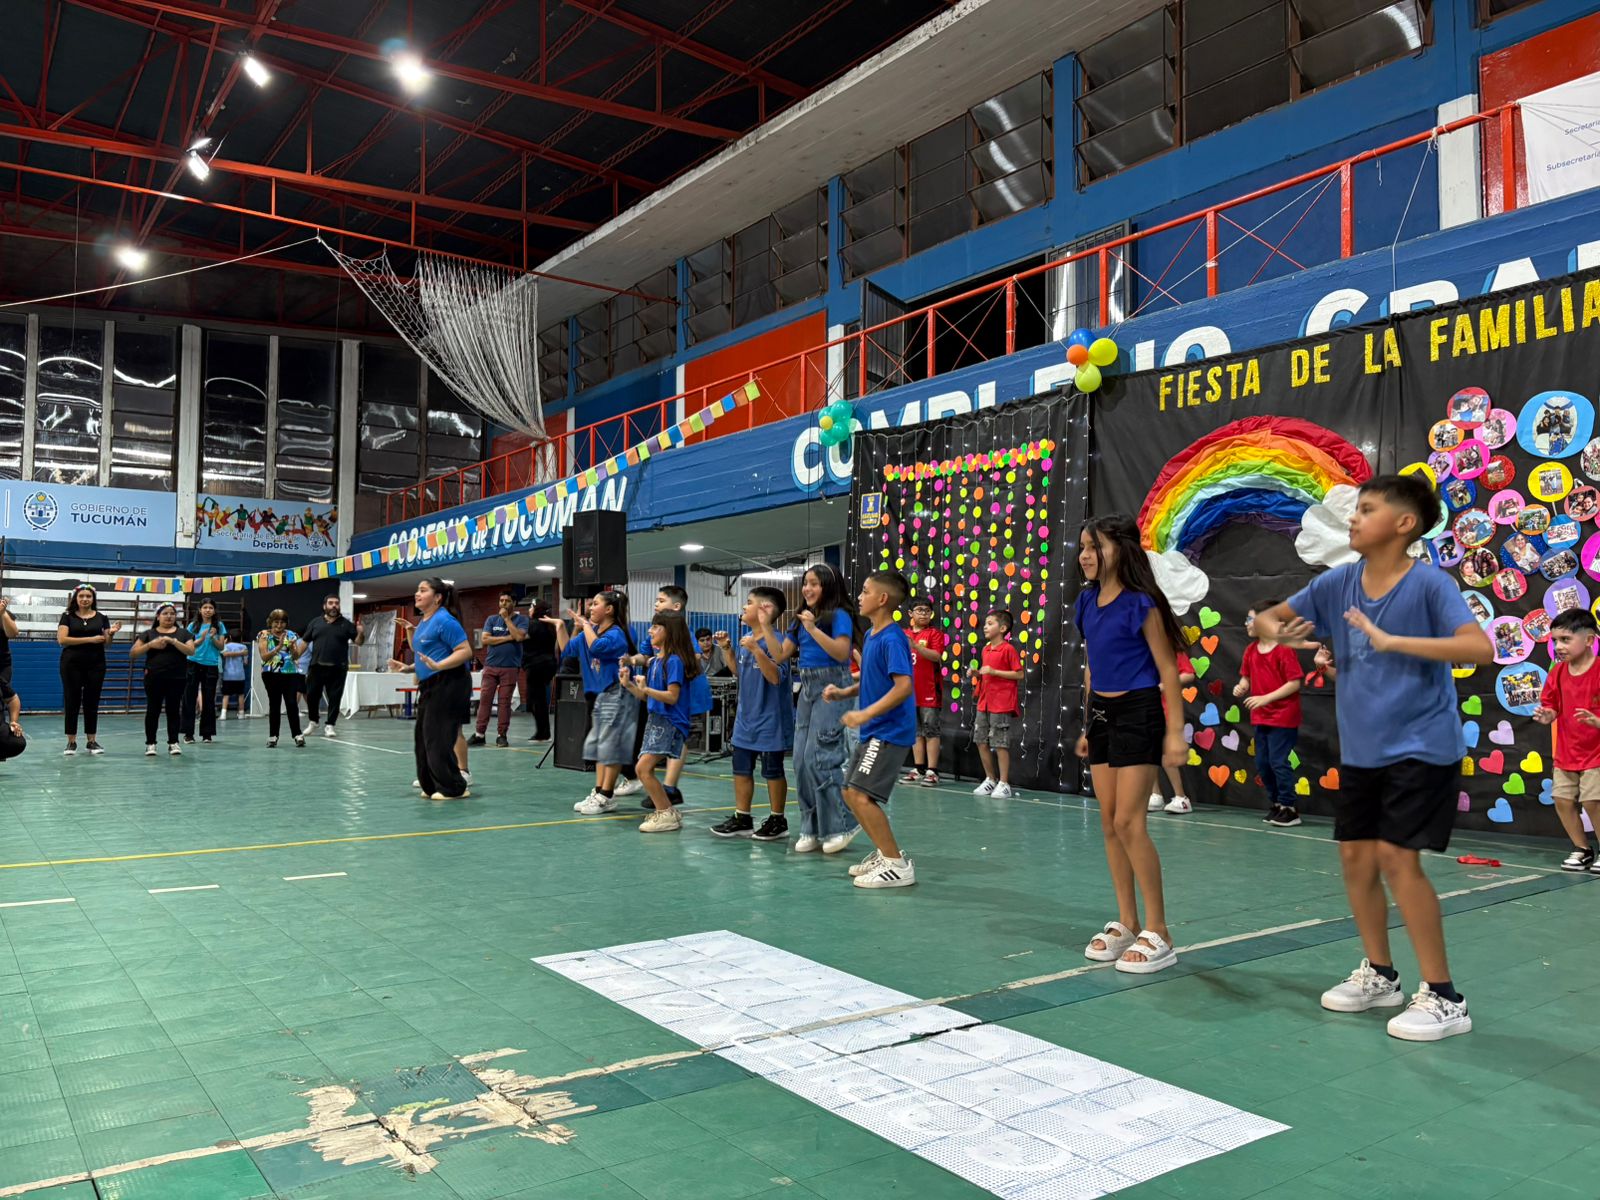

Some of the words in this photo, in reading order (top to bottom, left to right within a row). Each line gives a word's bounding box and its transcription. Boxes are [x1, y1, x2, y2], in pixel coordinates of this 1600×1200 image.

[1159, 359, 1260, 411] FIESTA
[1291, 343, 1330, 388] DE
[1364, 327, 1402, 374] LA
[1430, 279, 1600, 362] FAMILIA
[71, 503, 129, 514] GOBIERNO
[132, 507, 147, 515] DE
[71, 513, 147, 527] TUCUMÁN
[253, 540, 299, 550] Deportes
